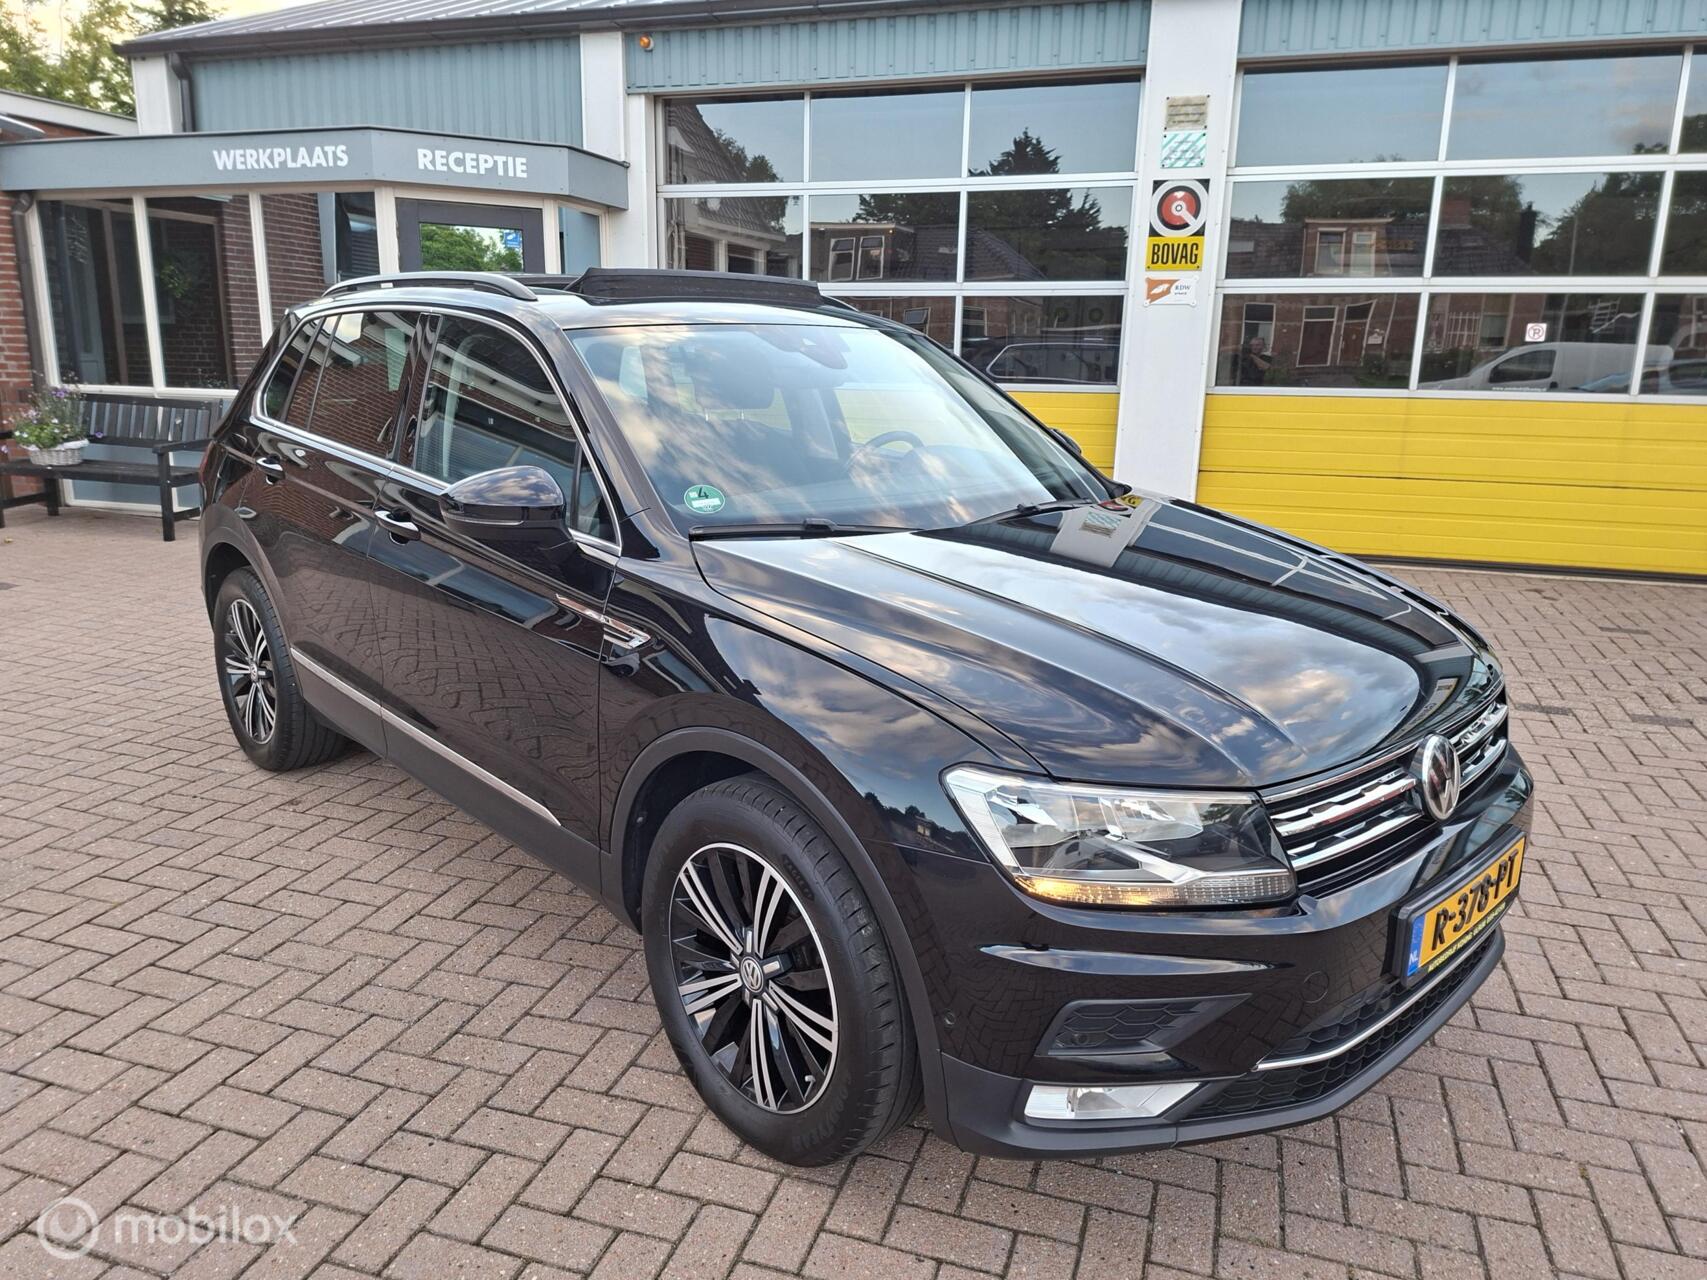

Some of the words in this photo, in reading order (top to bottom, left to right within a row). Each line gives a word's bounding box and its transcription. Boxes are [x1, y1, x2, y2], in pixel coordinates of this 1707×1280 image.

[212, 144, 349, 171] WERKPLAATS
[416, 148, 528, 179] RECEPTIE
[1150, 242, 1199, 265] BOVAG
[697, 486, 709, 499] 4
[1431, 848, 1520, 952] R-378-PT
[1408, 949, 1419, 965] NL
